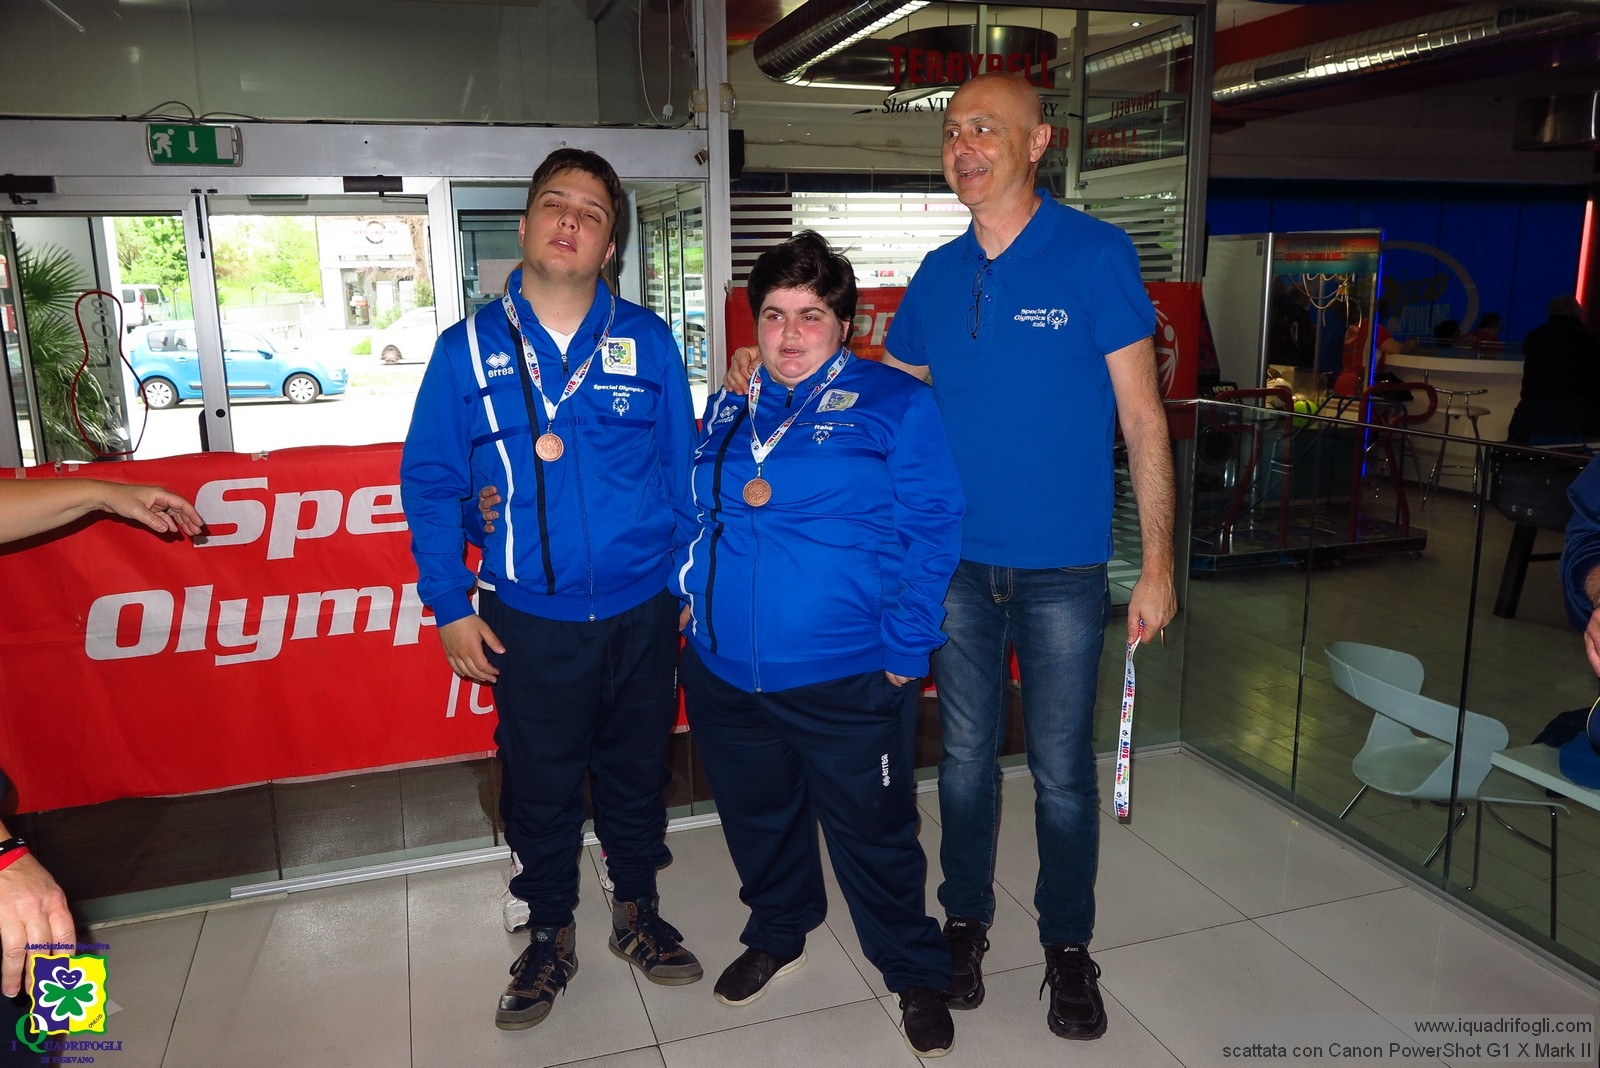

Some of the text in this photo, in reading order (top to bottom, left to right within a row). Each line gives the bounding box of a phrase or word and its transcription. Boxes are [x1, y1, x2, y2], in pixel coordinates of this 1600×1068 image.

[882, 98, 910, 115] Slot
[915, 103, 923, 112] &
[1021, 308, 1047, 316] Special
[1014, 314, 1046, 322] Olympics
